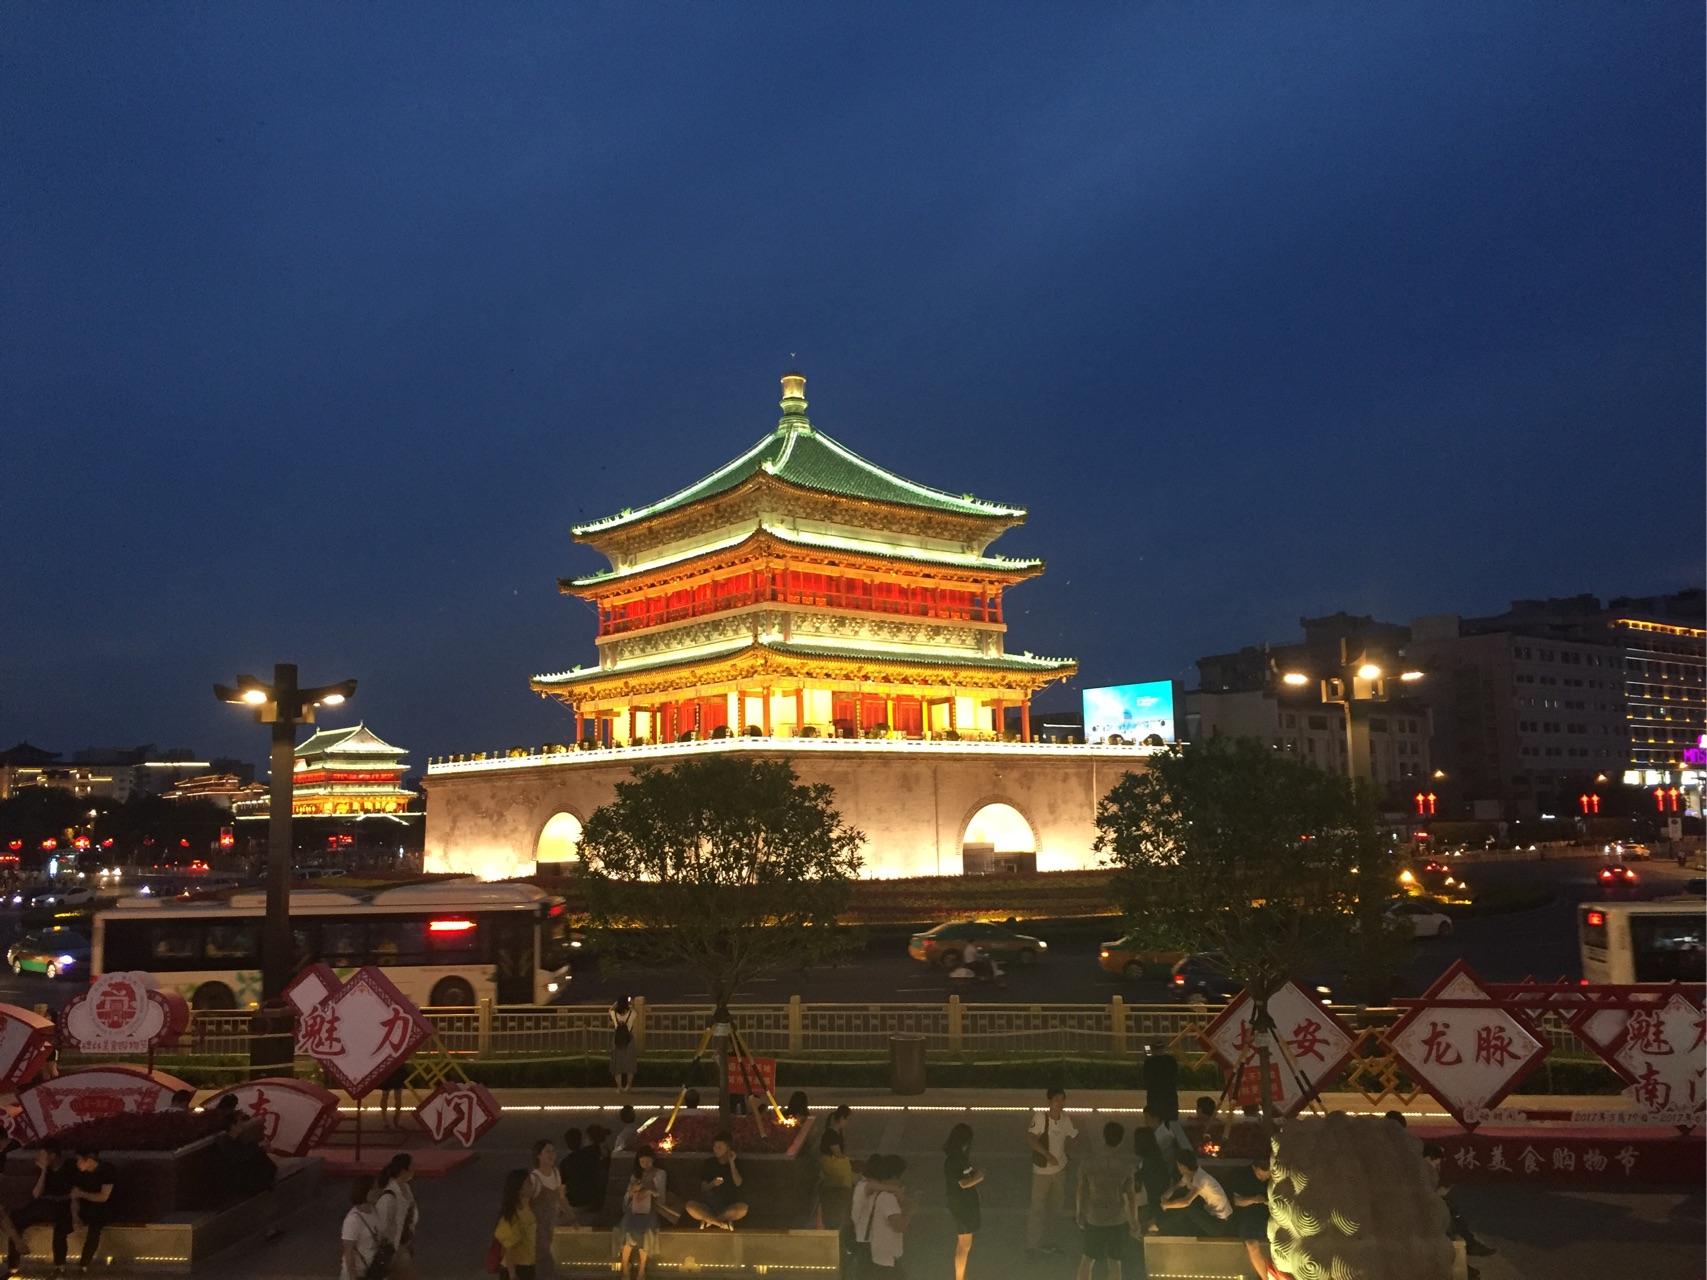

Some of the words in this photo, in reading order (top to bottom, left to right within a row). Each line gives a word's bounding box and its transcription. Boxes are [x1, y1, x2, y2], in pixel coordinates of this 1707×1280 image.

[297, 1004, 411, 1057] 魅力
[1421, 1022, 1522, 1067] 龙脉
[434, 1093, 475, 1146] 门
[1440, 1145, 1640, 1176] 林美食购物节
